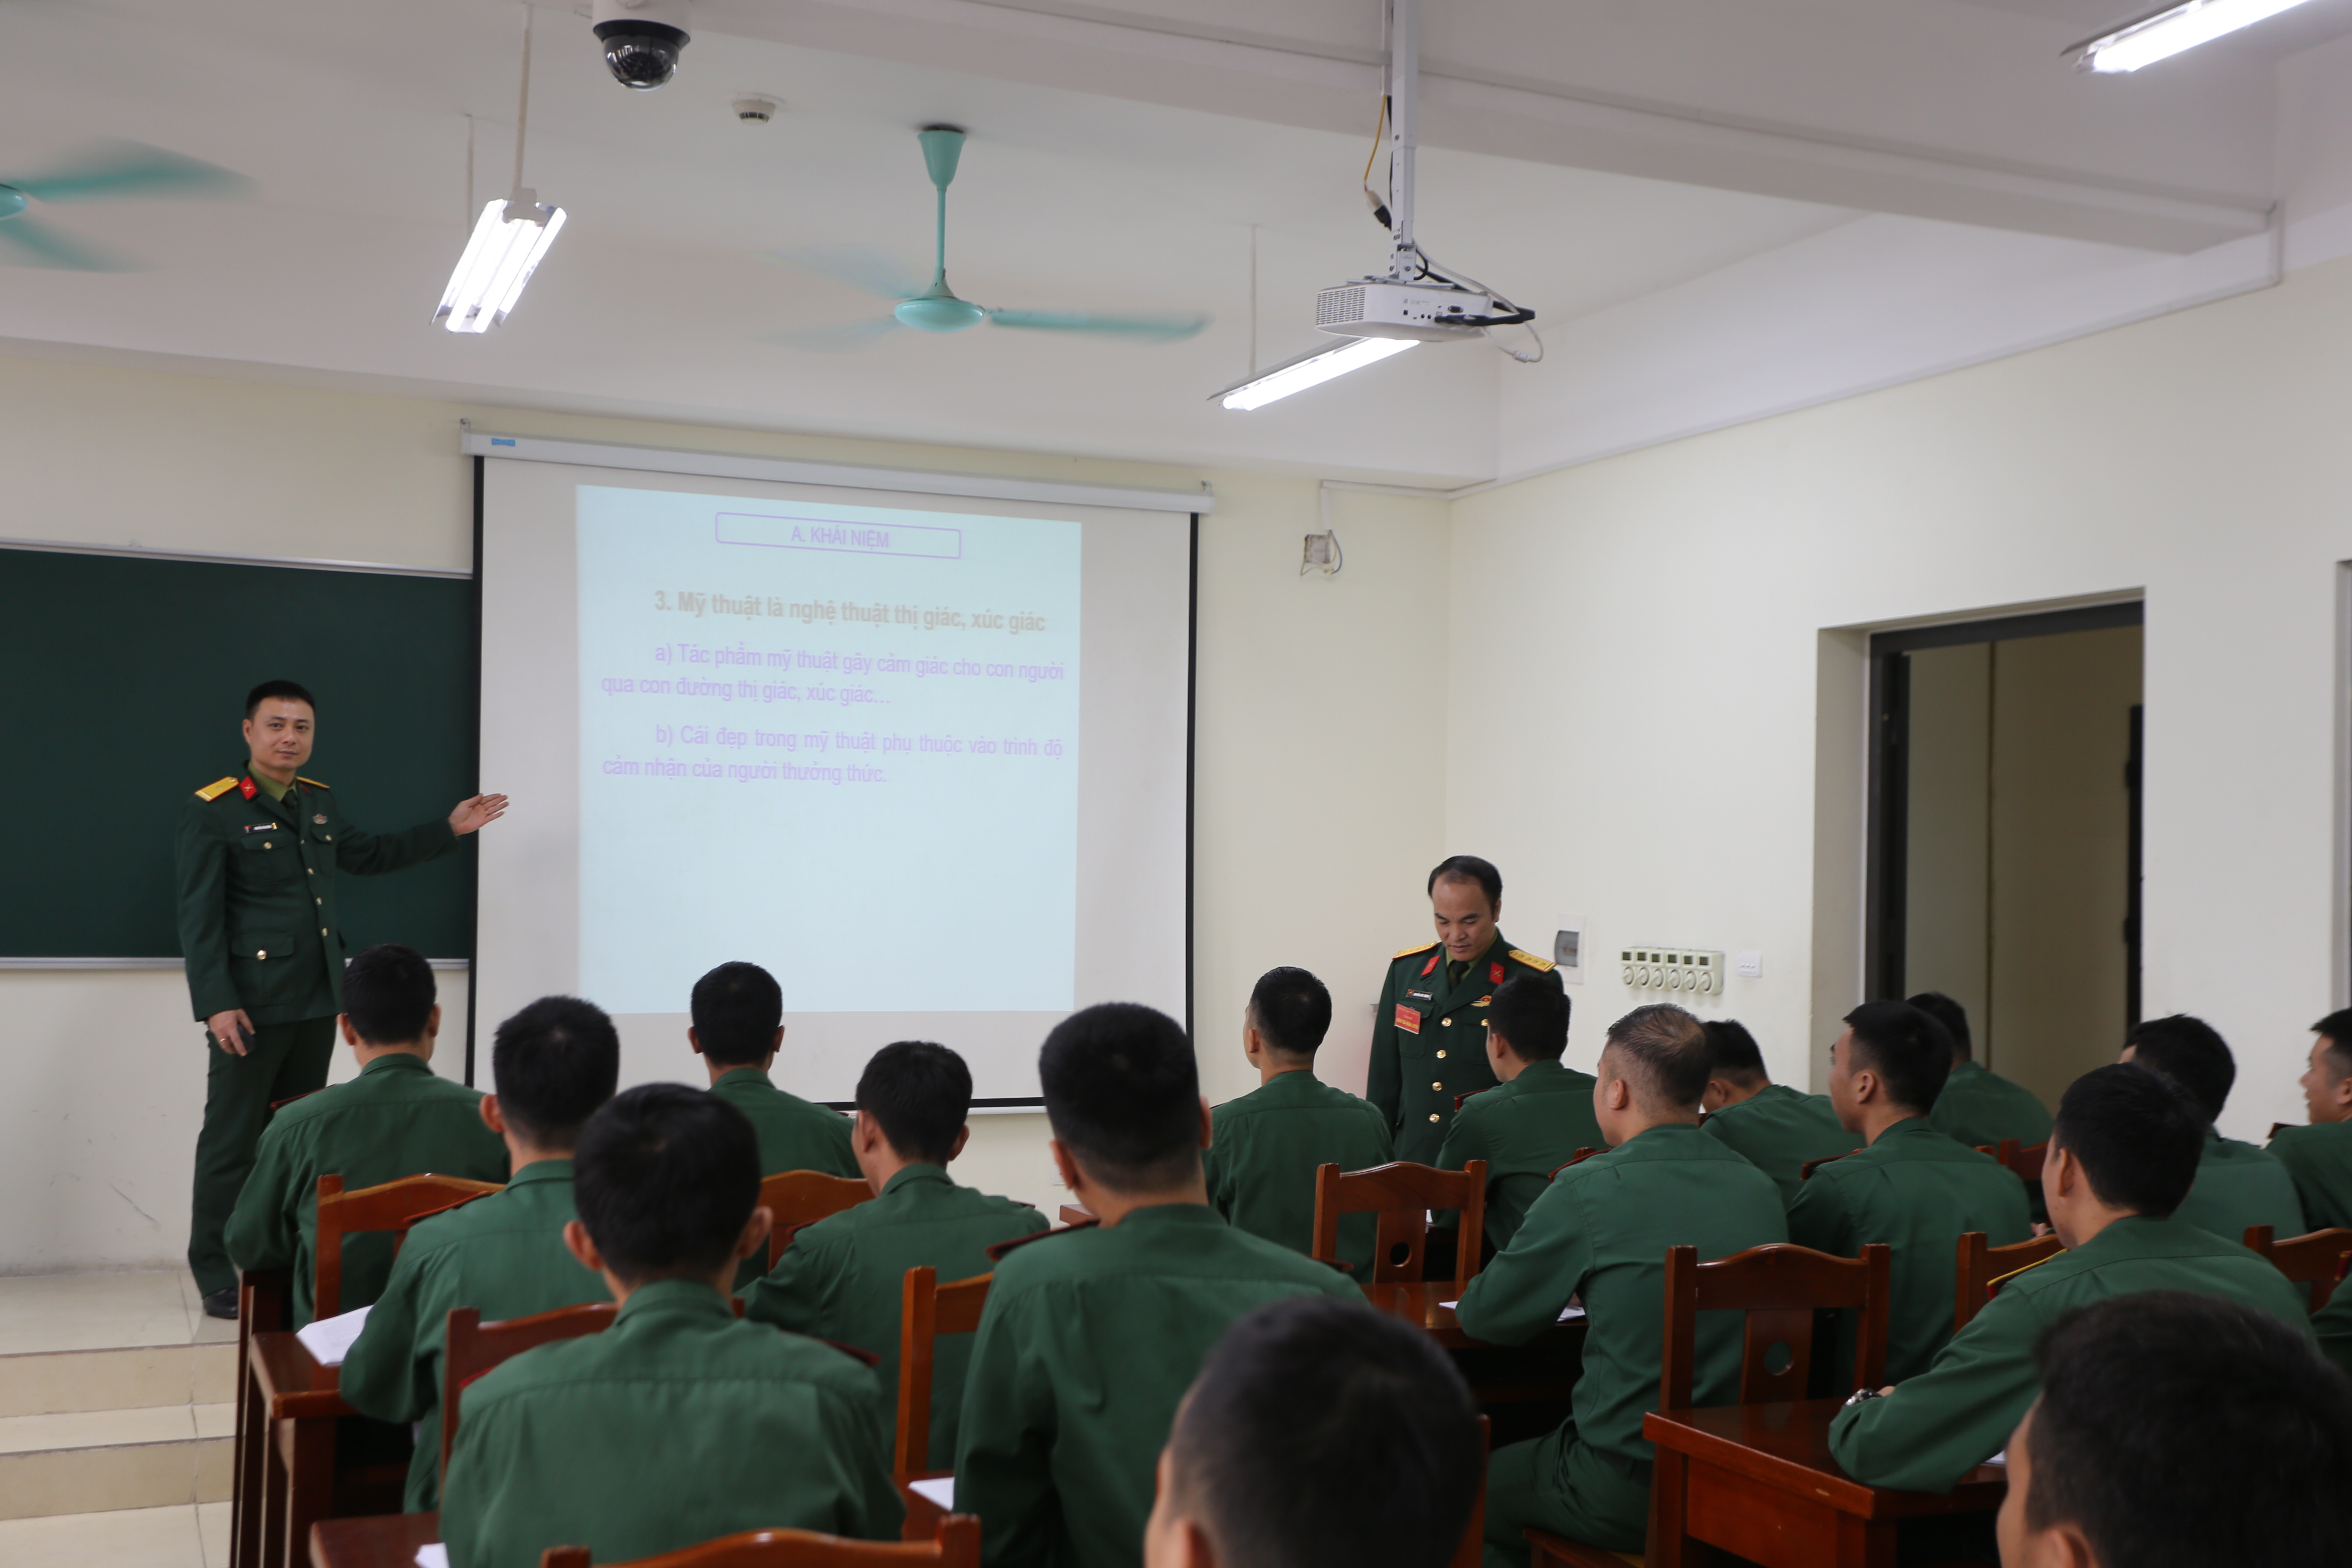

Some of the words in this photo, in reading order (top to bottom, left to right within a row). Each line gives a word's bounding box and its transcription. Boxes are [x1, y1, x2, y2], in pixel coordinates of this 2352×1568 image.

[791, 526, 805, 542] A.
[811, 526, 846, 545] KHÁI
[851, 530, 889, 549] NIỆM
[655, 590, 671, 610] 3.
[678, 591, 706, 618] Mỹ
[711, 594, 762, 620] thuật
[767, 597, 784, 617] là
[790, 600, 836, 625] nghệ
[841, 602, 890, 628] thuật
[894, 605, 918, 629] thị
[923, 606, 966, 630] giác,
[971, 609, 1003, 629] xúc
[1009, 612, 1046, 635] giác
[655, 643, 672, 665] a)
[677, 643, 710, 663] Tác
[715, 641, 762, 668] phẩm
[767, 649, 792, 671] mỹ
[796, 650, 839, 672] thuật
[843, 652, 872, 675] gây
[877, 653, 911, 672] cảm
[916, 656, 949, 678] giác
[953, 658, 981, 676] cho
[986, 664, 1014, 677] con
[1019, 662, 1064, 683] người
[602, 678, 635, 696] qua
[640, 680, 671, 694] con
[676, 677, 732, 701] đường
[737, 680, 757, 701] thị
[763, 681, 801, 703] giác,
[806, 683, 836, 701] xúc
[656, 725, 673, 747] b)
[680, 725, 708, 744] Cái
[716, 727, 747, 749] đẹp
[755, 729, 797, 752] trong
[804, 731, 829, 752] mỹ
[836, 732, 876, 753] thuật
[883, 733, 912, 754] phụ
[919, 735, 962, 756] thuộc
[969, 736, 997, 754] vào
[1003, 737, 1037, 755] trình
[1044, 738, 1063, 760] độ
[603, 755, 639, 775] cảm
[645, 758, 687, 780] nhận
[692, 758, 723, 778] của
[728, 761, 777, 782] người
[782, 761, 842, 785] thưởng
[846, 764, 887, 782] thức.
